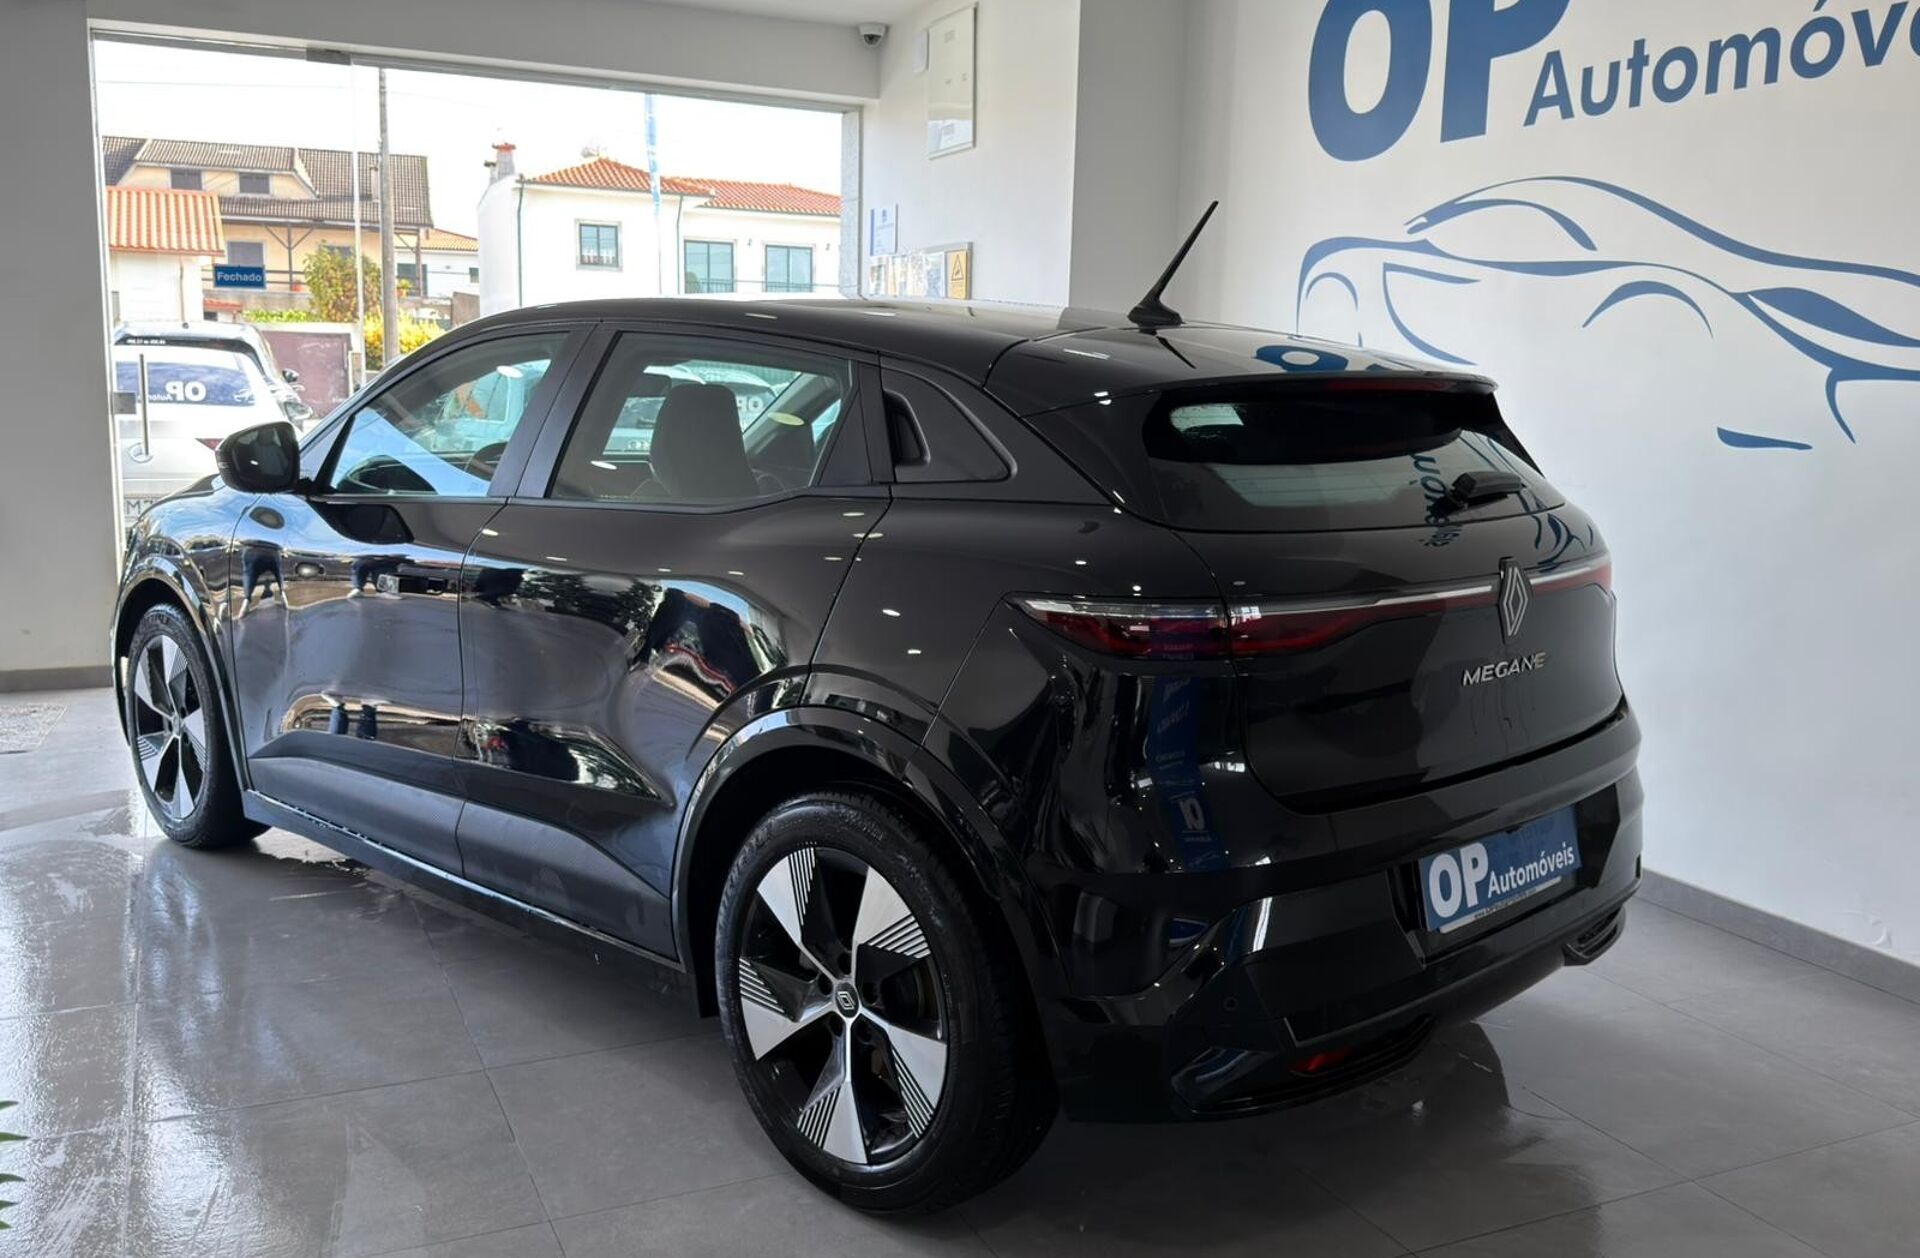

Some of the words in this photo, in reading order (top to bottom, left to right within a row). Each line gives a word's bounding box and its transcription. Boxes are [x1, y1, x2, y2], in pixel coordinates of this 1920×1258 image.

[1308, 0, 1571, 162] OP
[1523, 0, 1920, 127] Automóv
[217, 271, 262, 282] Fechado
[1462, 651, 1547, 687] MEGANE
[1428, 841, 1488, 919] OP
[1486, 840, 1575, 899] Automóveis
